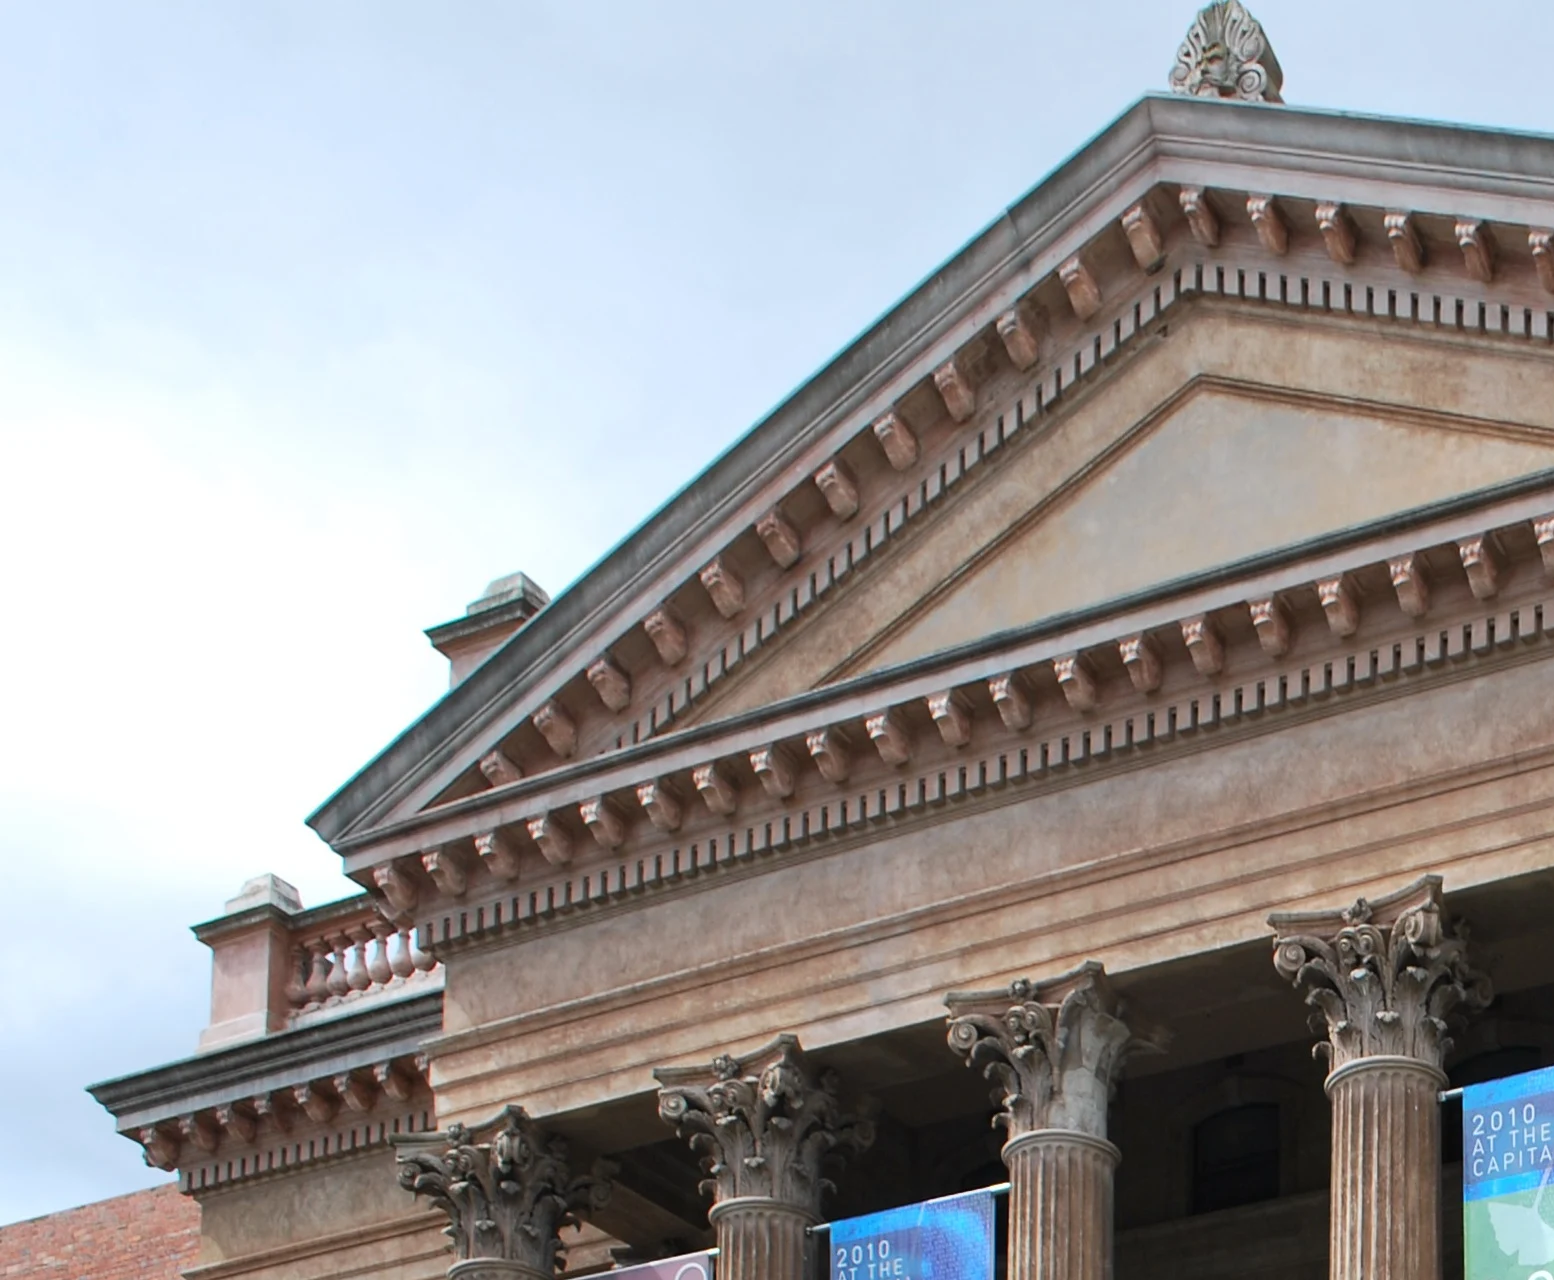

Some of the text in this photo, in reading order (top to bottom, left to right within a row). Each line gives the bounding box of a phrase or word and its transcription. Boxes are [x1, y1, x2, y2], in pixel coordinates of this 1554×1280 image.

[1472, 1103, 1535, 1136] 2010
[1472, 1122, 1551, 1157] AT THE
[837, 1240, 889, 1268] 2010
[868, 1258, 904, 1280] THE
